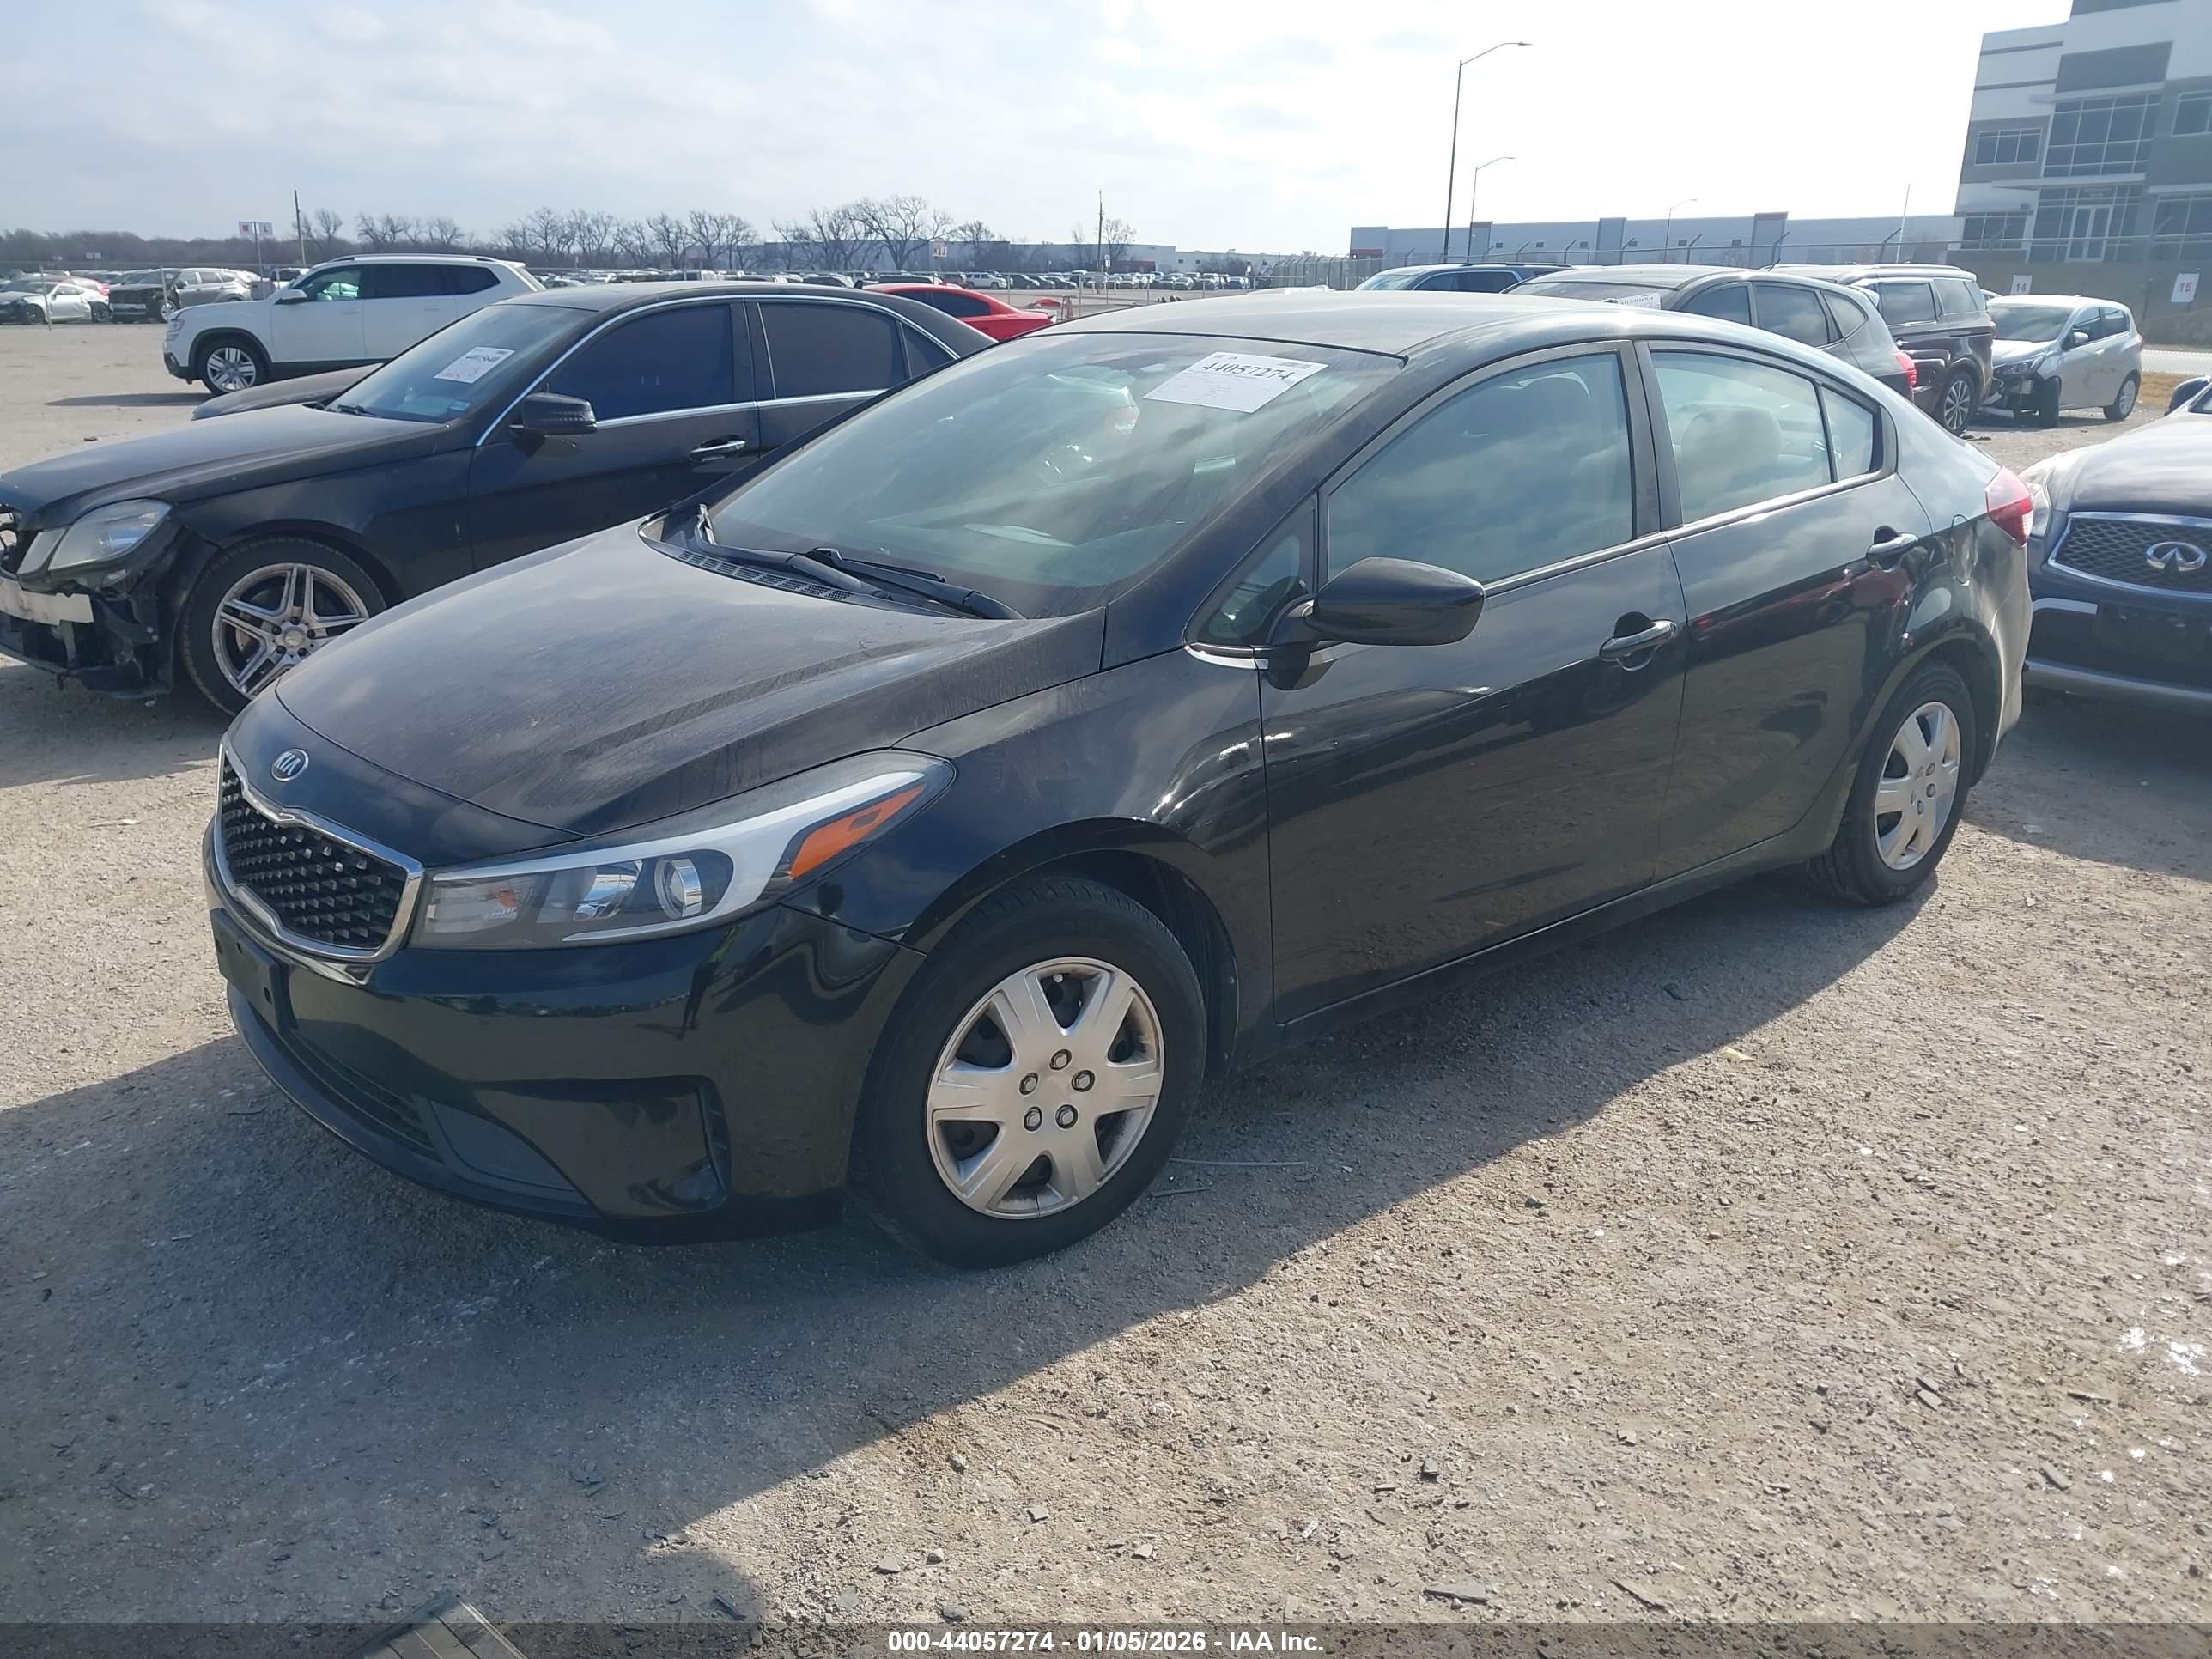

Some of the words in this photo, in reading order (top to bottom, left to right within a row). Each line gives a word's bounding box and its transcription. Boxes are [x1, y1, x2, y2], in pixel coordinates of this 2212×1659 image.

[2015, 283, 2027, 293] 14
[2179, 282, 2192, 293] 15
[1202, 362, 1296, 380] 44057274
[274, 750, 301, 776] KIA
